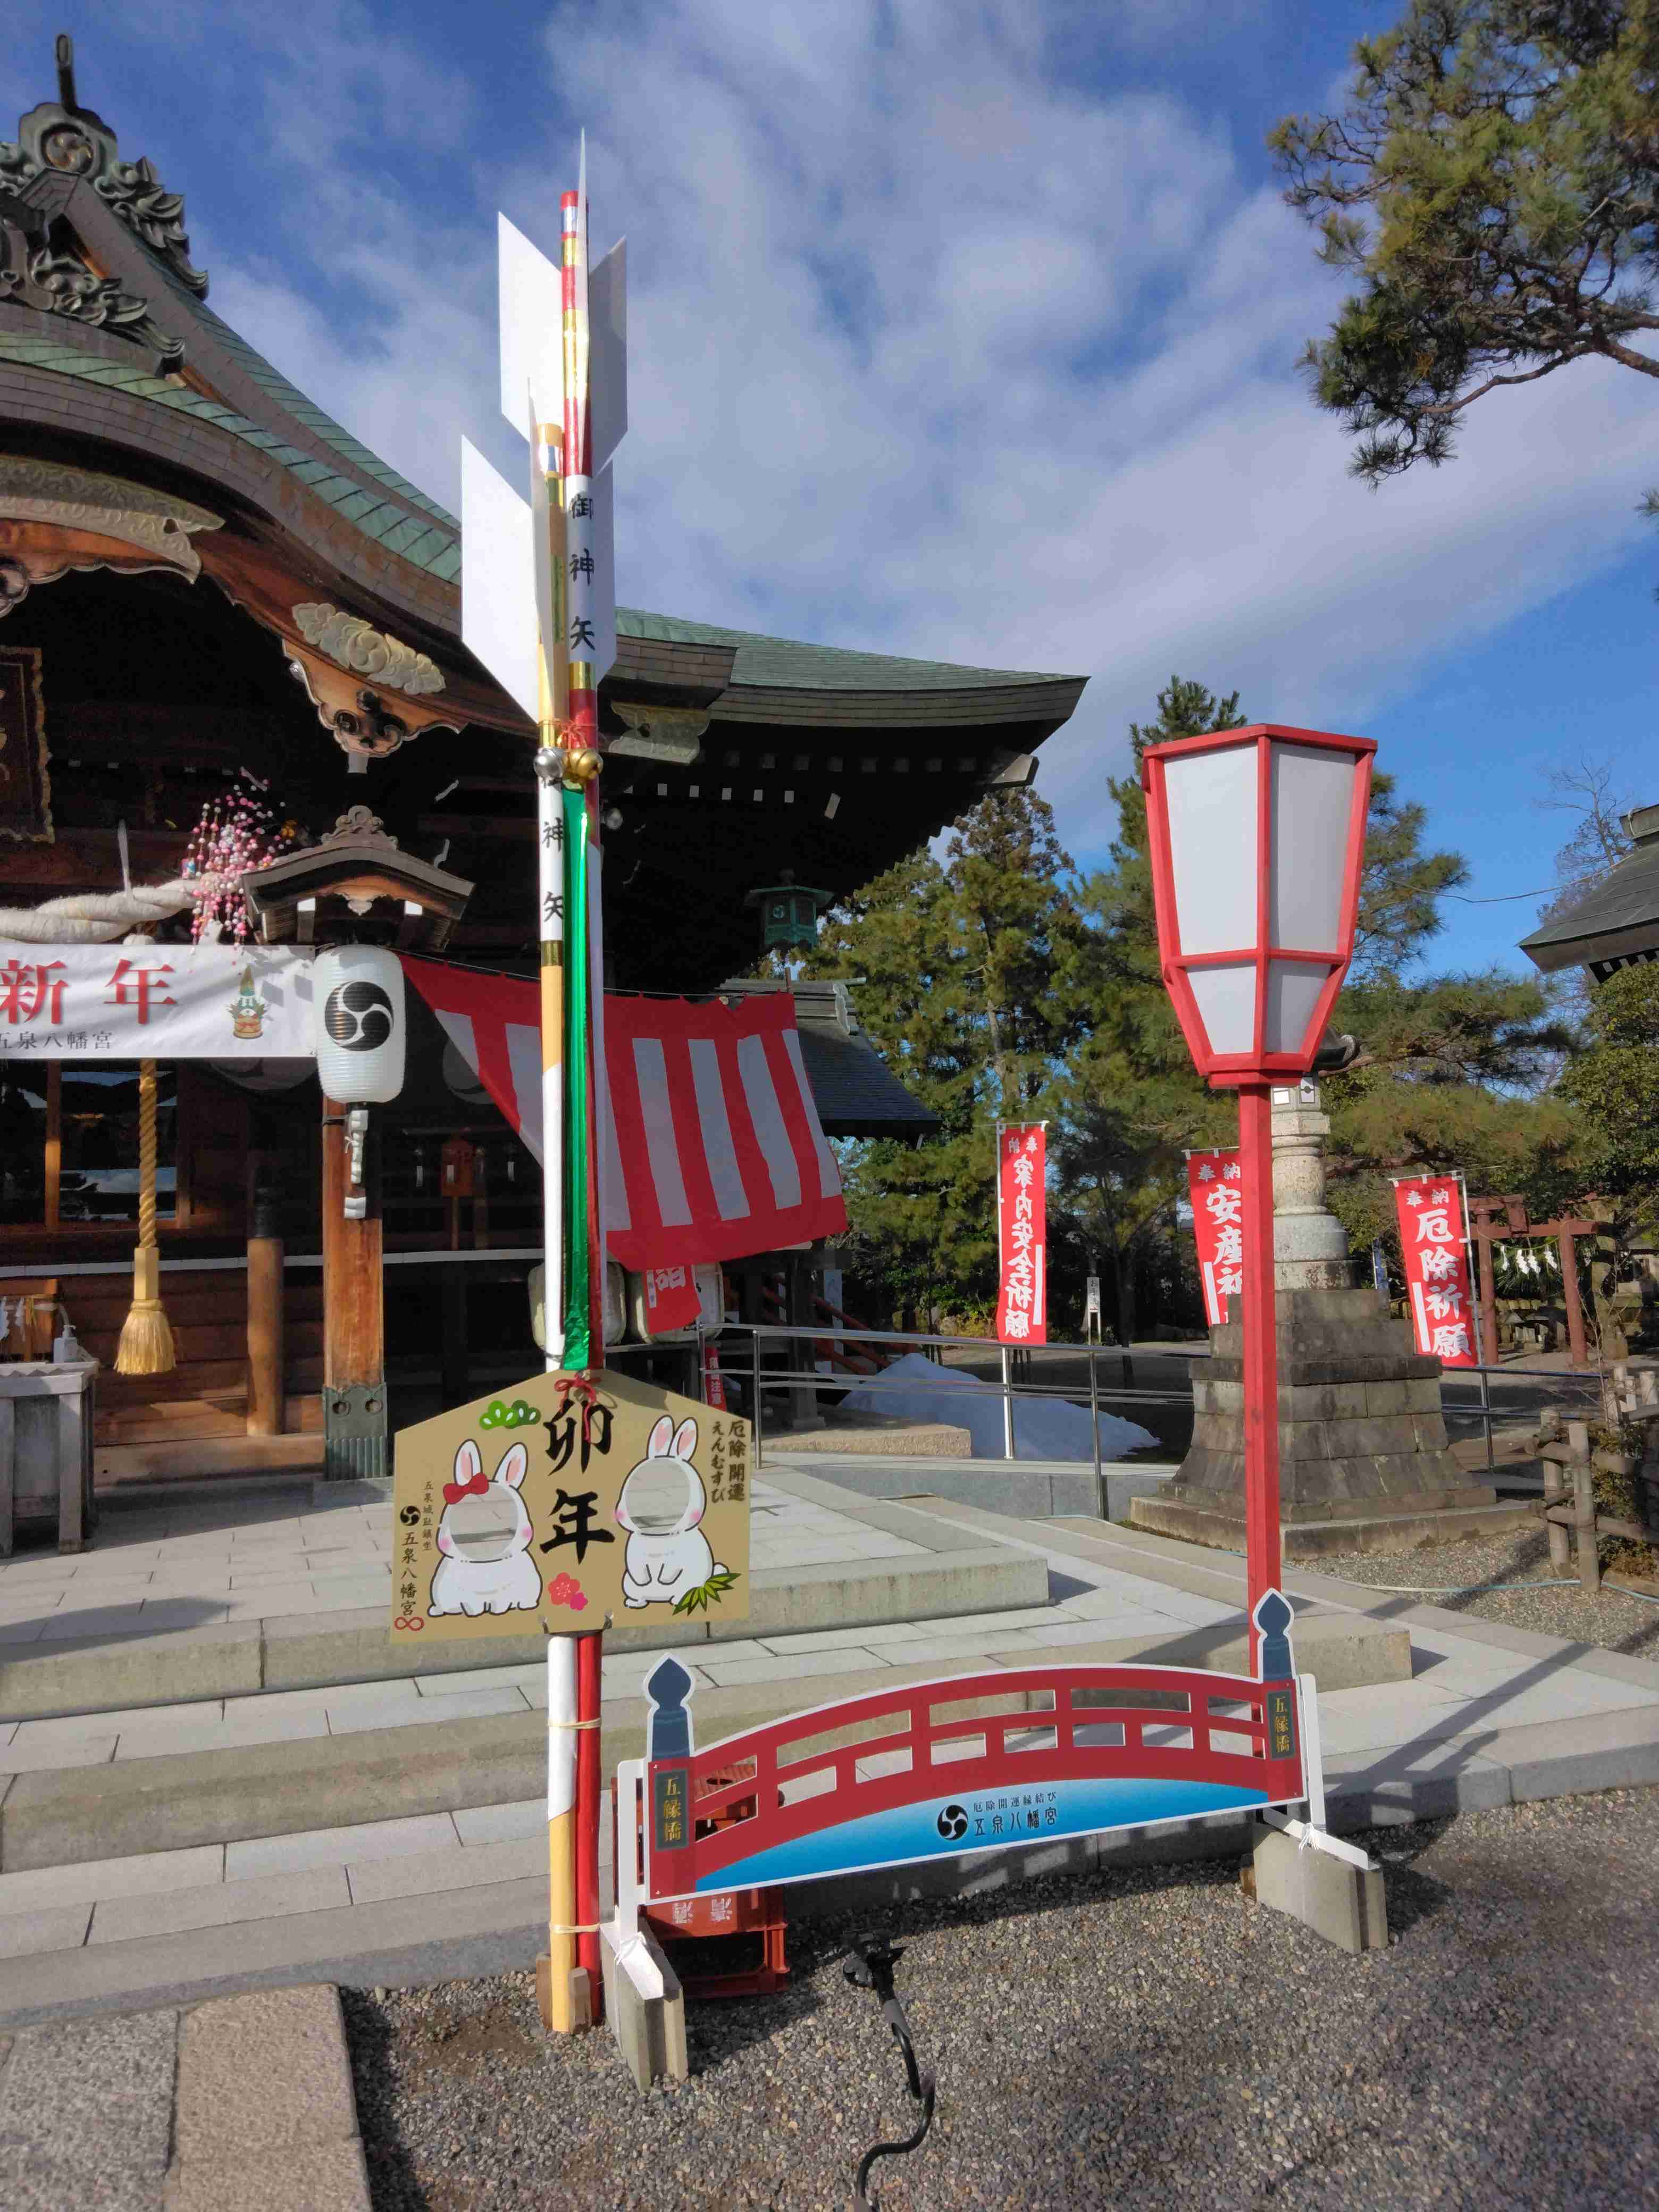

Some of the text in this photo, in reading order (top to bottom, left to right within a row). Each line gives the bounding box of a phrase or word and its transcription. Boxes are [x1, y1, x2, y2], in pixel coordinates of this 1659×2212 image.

[569, 493, 595, 651] 御神矢
[0, 959, 177, 1025] 新年
[0, 1031, 113, 1050] 五泉八幡宮
[1197, 1162, 1241, 1183] 奉納
[1405, 1189, 1450, 1208] 奉納
[1205, 1184, 1242, 1323] 安産祈
[1415, 1208, 1472, 1358] 厄除祈願
[539, 1398, 615, 1565] 卯年
[710, 1420, 725, 1504] えんむすび
[400, 1531, 418, 1616] 五泉八幡宮
[974, 1791, 1057, 1813] 厄除開運縁結び
[974, 1806, 1057, 1837] 五泉八幡宮
